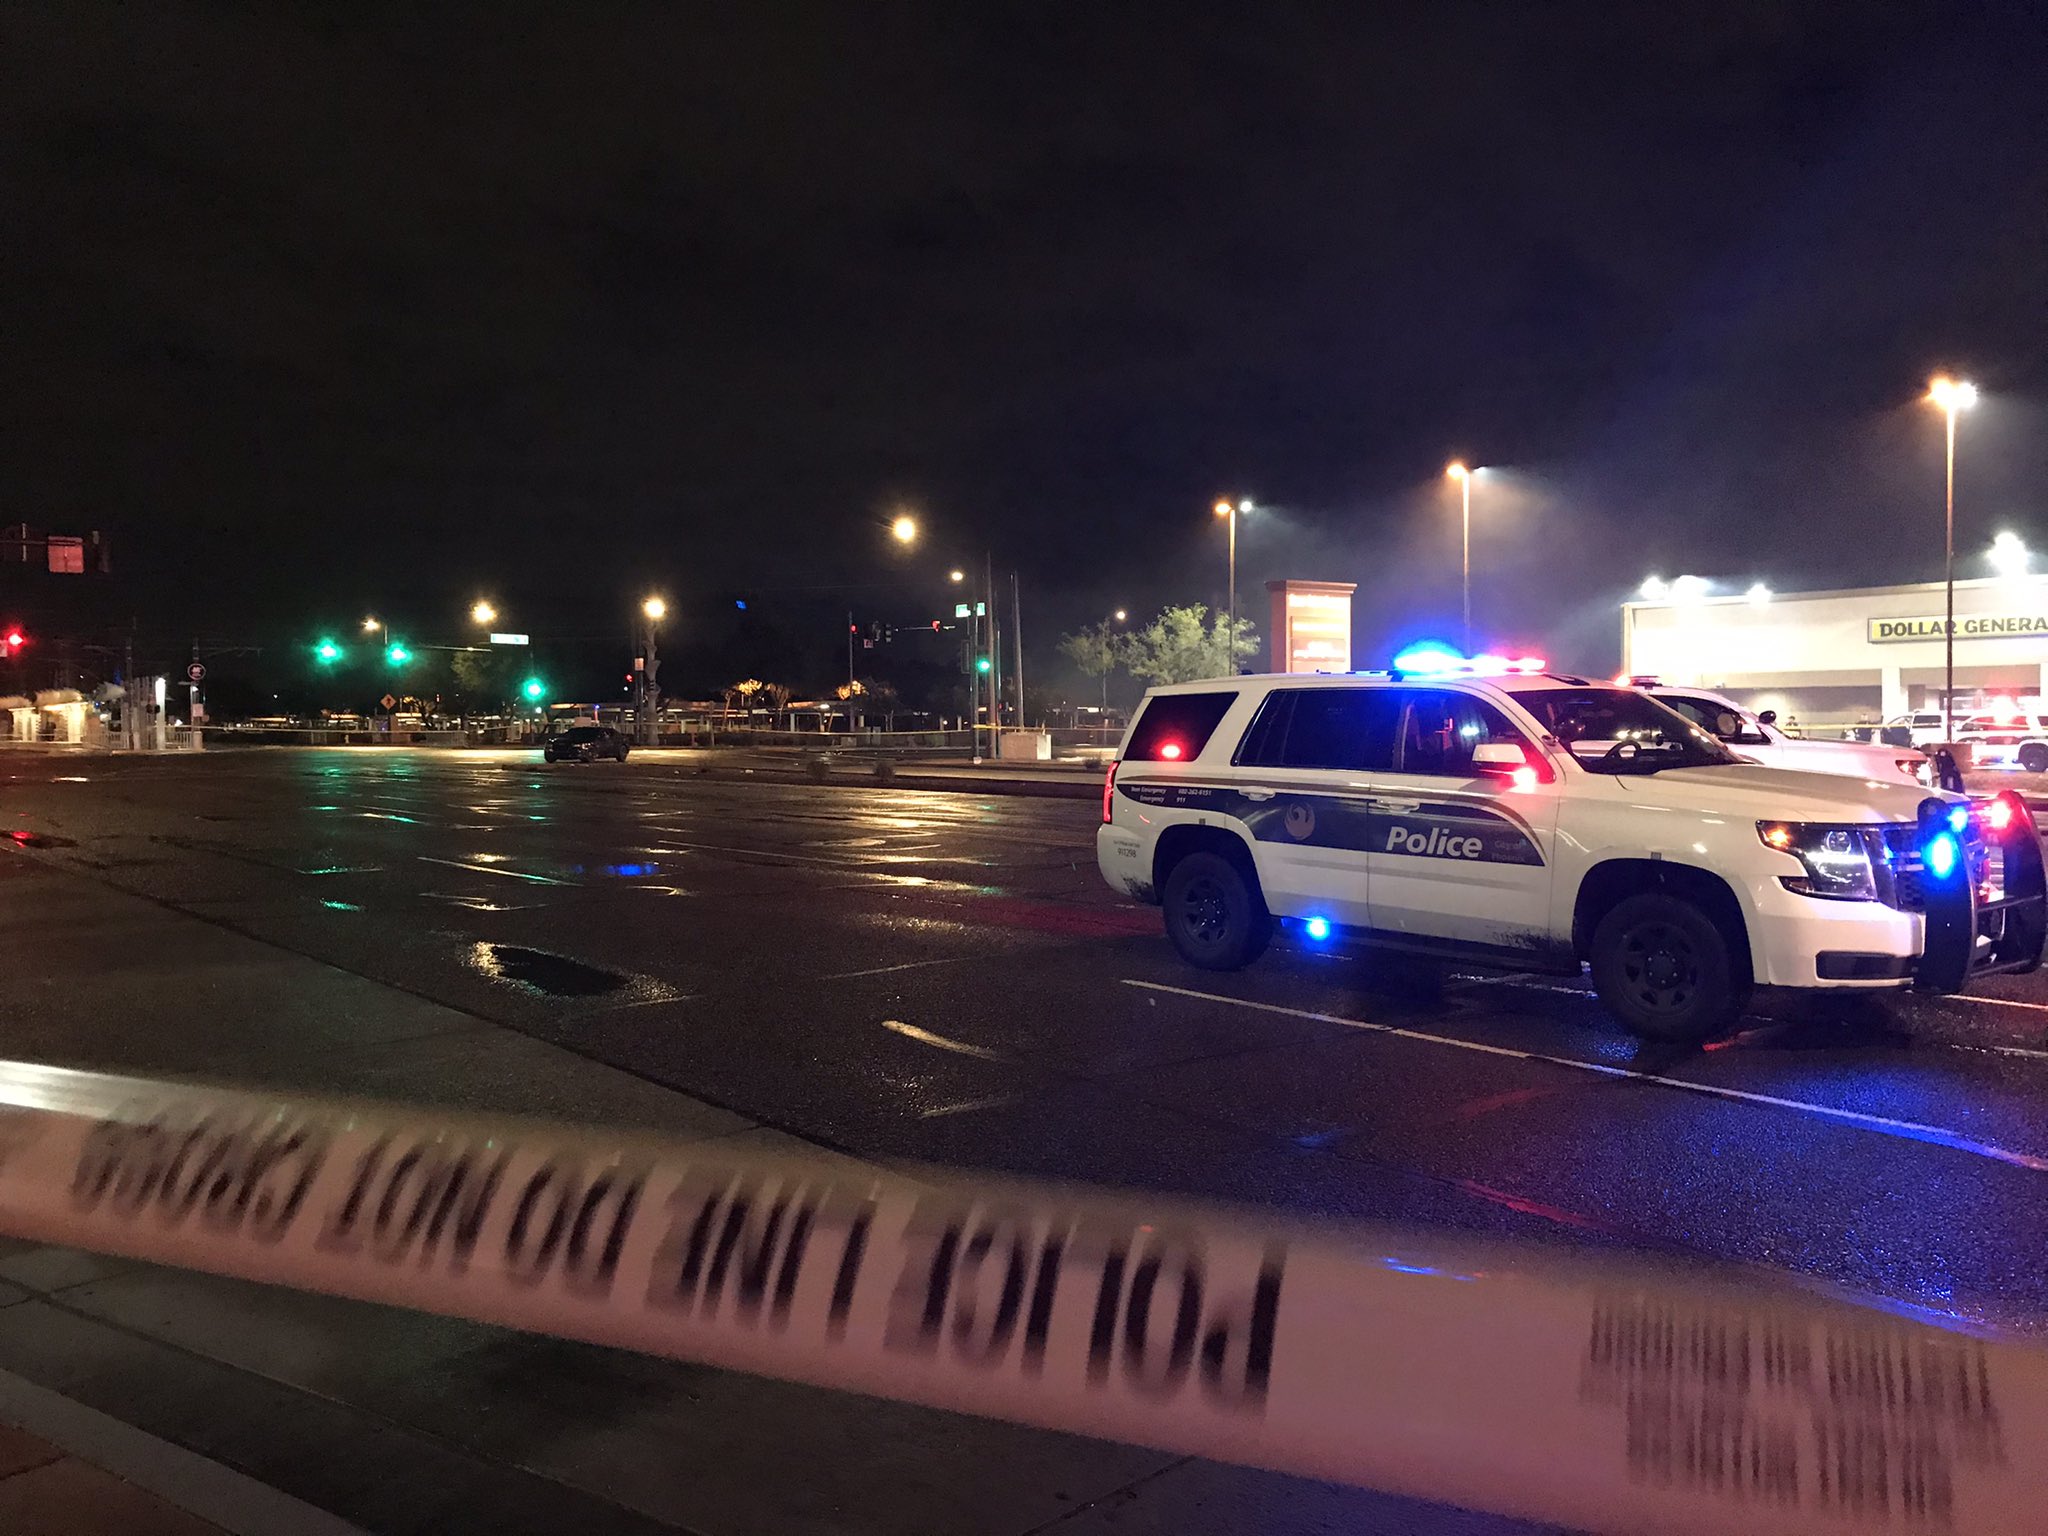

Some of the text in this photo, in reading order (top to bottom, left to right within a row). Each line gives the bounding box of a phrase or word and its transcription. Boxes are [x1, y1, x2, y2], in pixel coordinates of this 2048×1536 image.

[1879, 617, 2048, 637] DOLLAR GENERA
[1139, 795, 1165, 803] Emergency
[1141, 786, 1167, 795] Emergency
[1385, 825, 1483, 858] Police
[313, 1115, 515, 1278] NOT
[505, 1143, 655, 1300] DO
[643, 1168, 880, 1347] LINE
[881, 1198, 1288, 1418] POLICE
